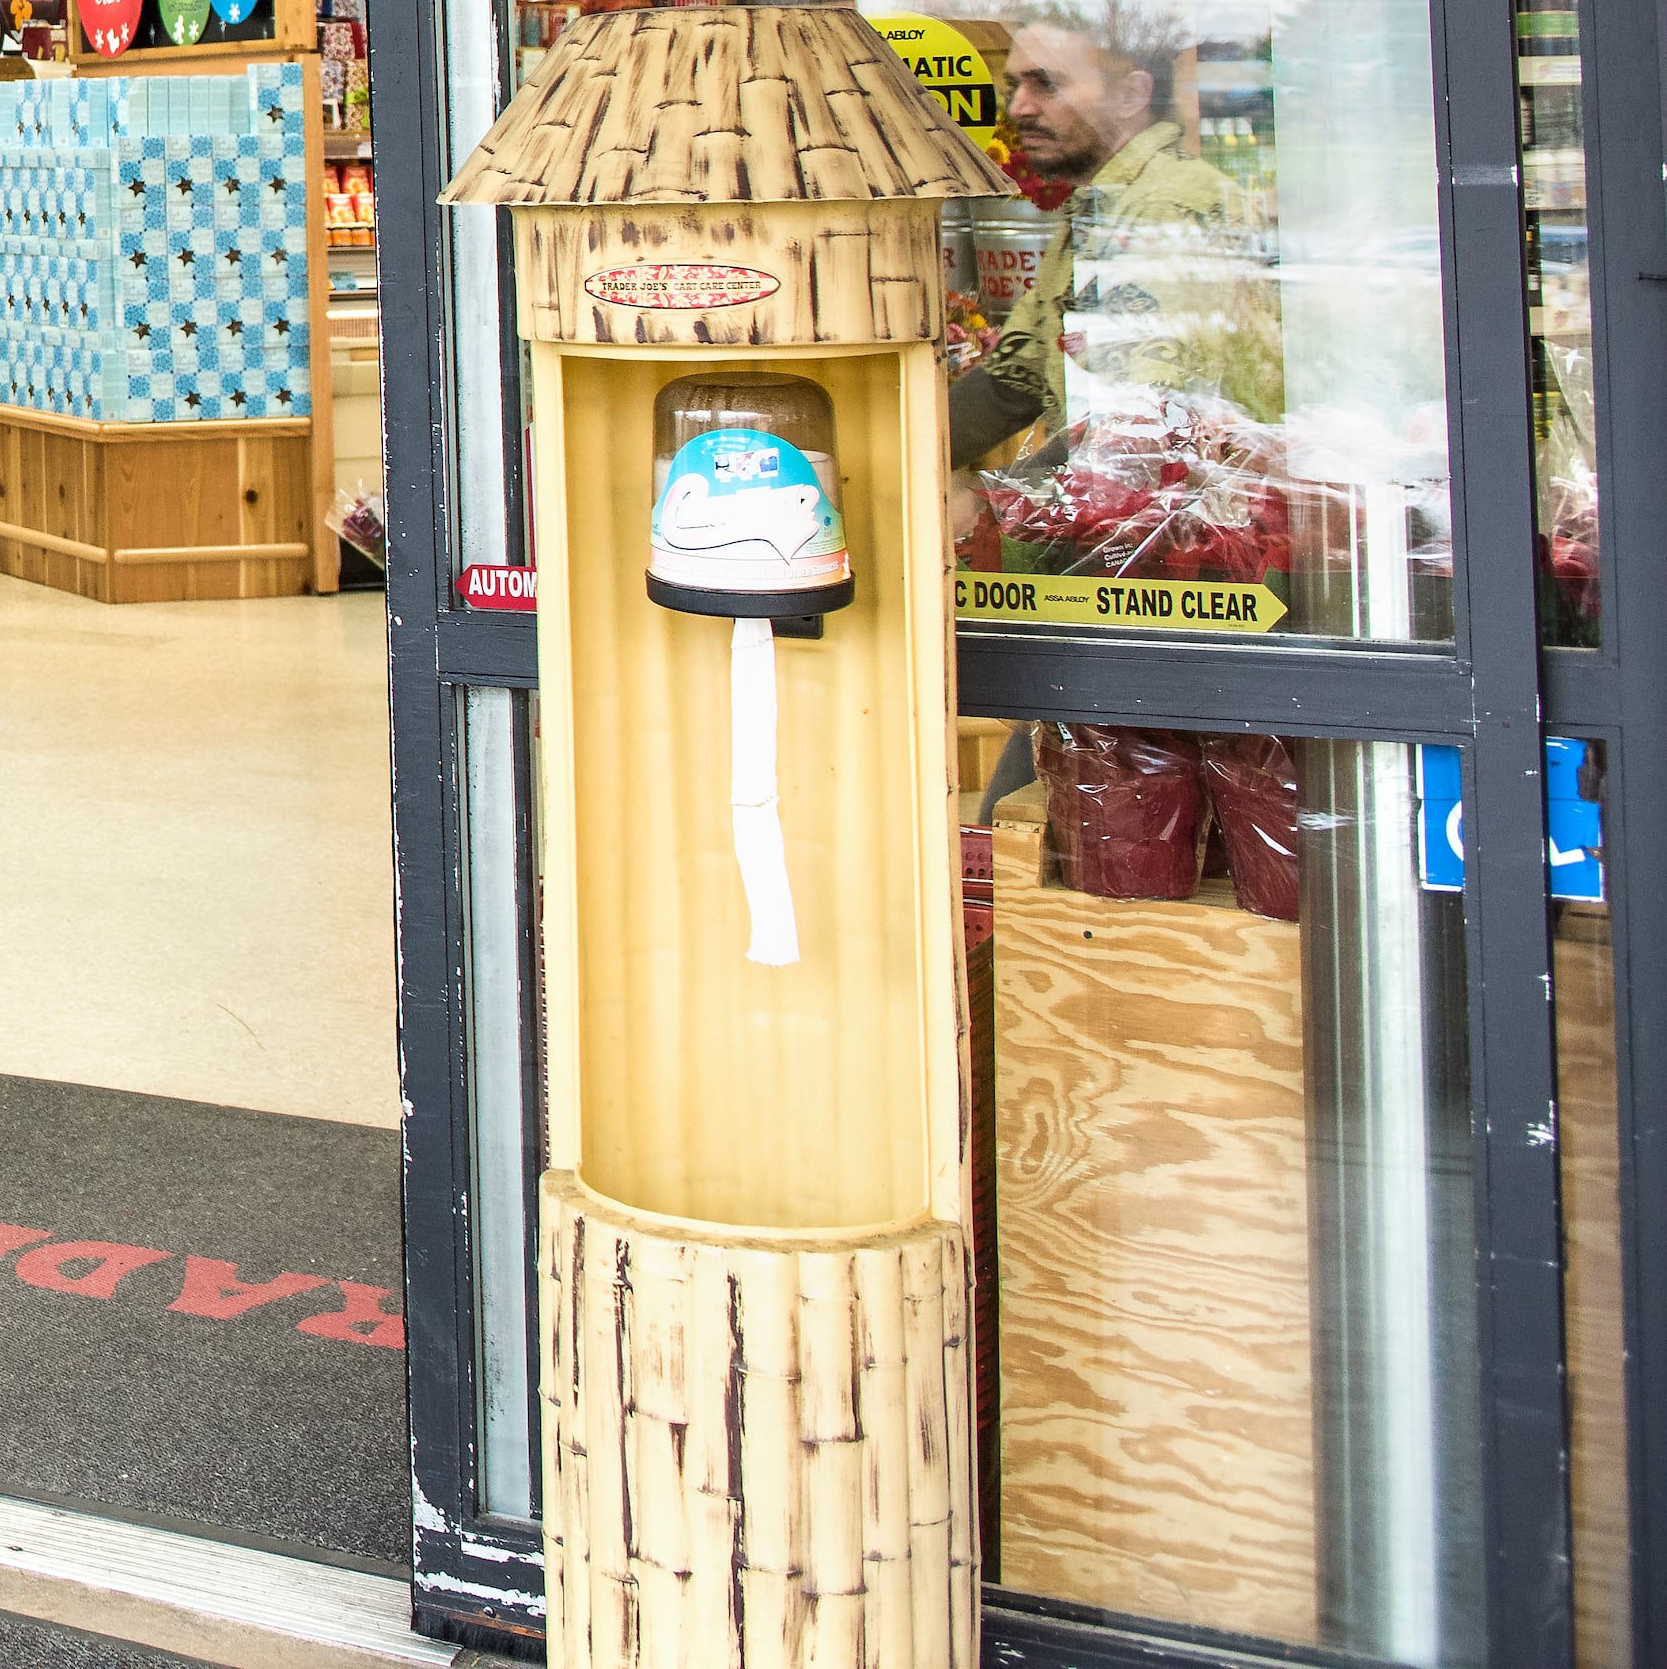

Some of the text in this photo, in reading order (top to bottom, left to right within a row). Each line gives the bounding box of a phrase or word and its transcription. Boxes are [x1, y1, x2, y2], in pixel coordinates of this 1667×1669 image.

[886, 30, 925, 41] ABLOY
[602, 281, 761, 291] TRADER JOE'S CART CARE CENTER
[974, 582, 1037, 611] DOOR
[1044, 593, 1065, 602] ASSA
[1065, 595, 1090, 604] ABLOY
[1096, 586, 1173, 618] STAND
[1181, 590, 1258, 622] CLEAR
